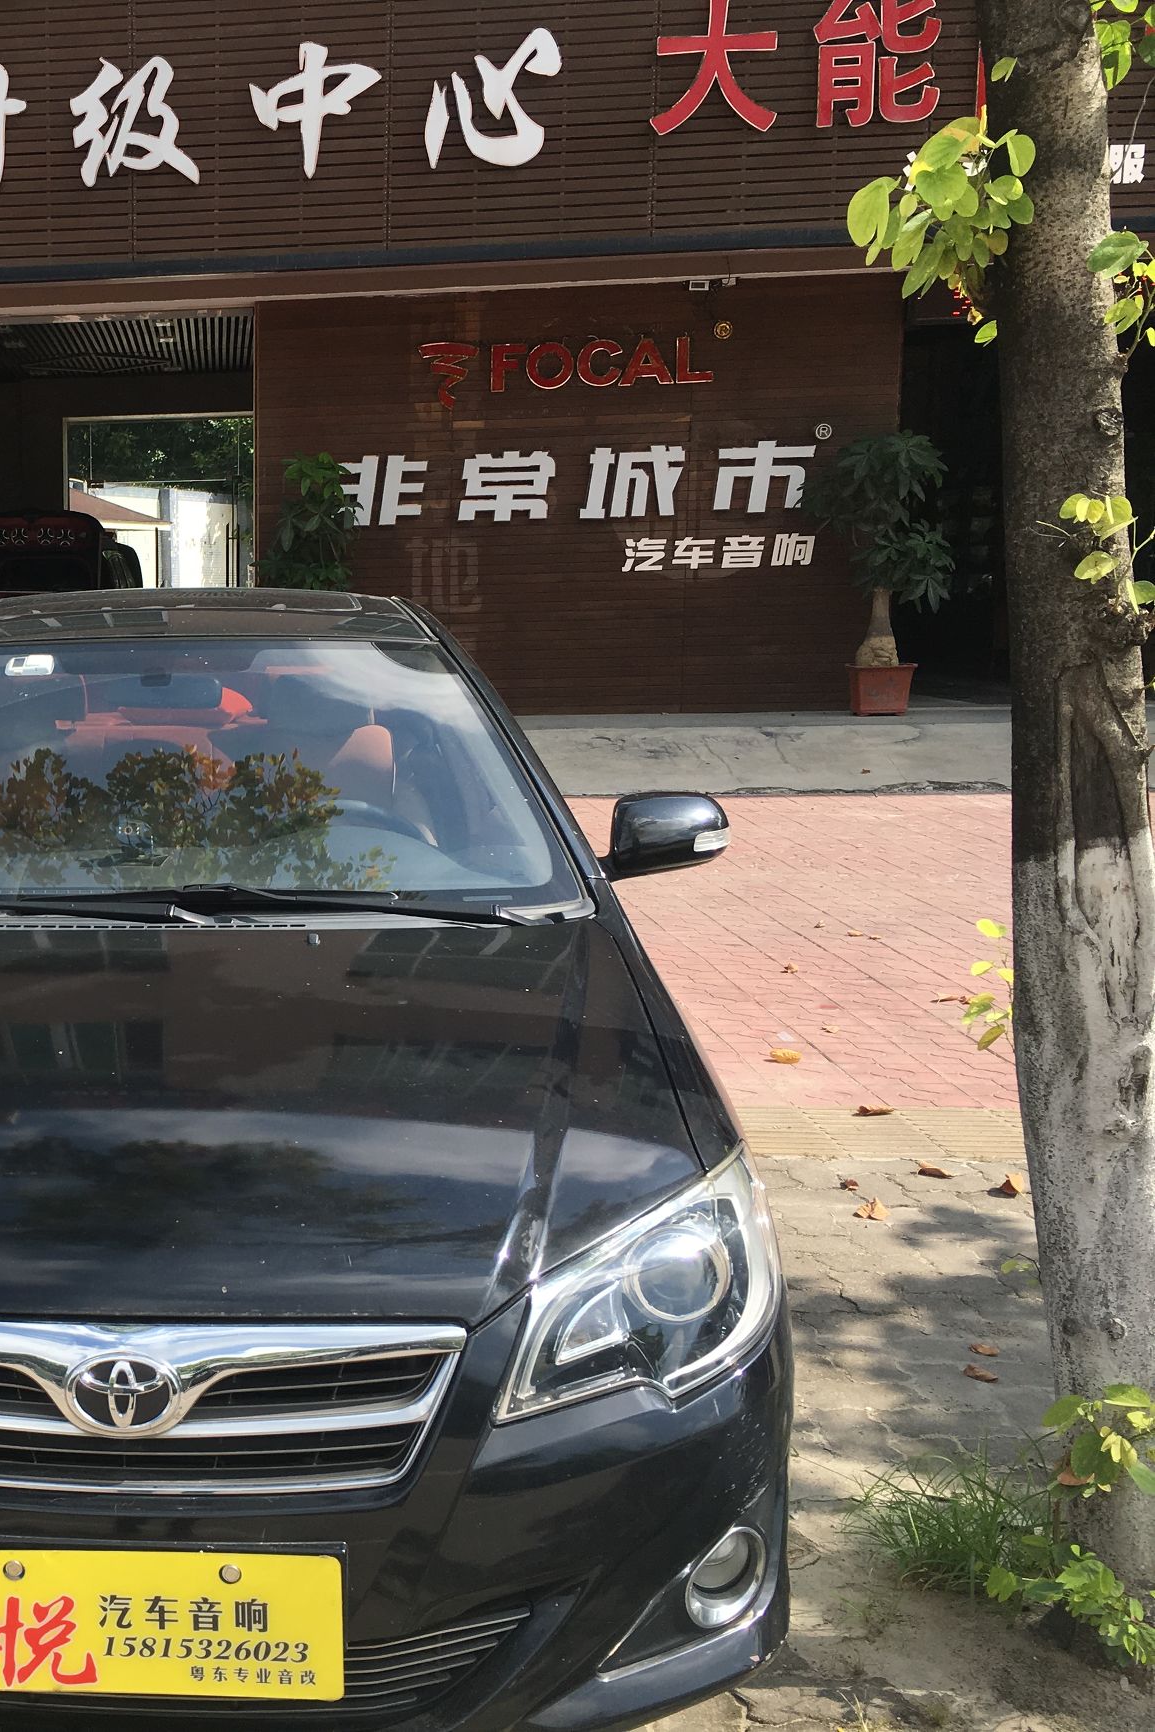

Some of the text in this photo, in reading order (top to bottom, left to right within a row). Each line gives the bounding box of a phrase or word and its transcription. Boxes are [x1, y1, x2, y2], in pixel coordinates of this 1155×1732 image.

[650, 0, 987, 135] 大能
[489, 334, 714, 393] FOCAL
[336, 439, 817, 527] 非常城市
[621, 531, 816, 574] 汽车音响
[98, 1594, 269, 1633] 汽车音响
[102, 1636, 310, 1664] 15815326023
[189, 1665, 317, 1687] 粤东专业音改
